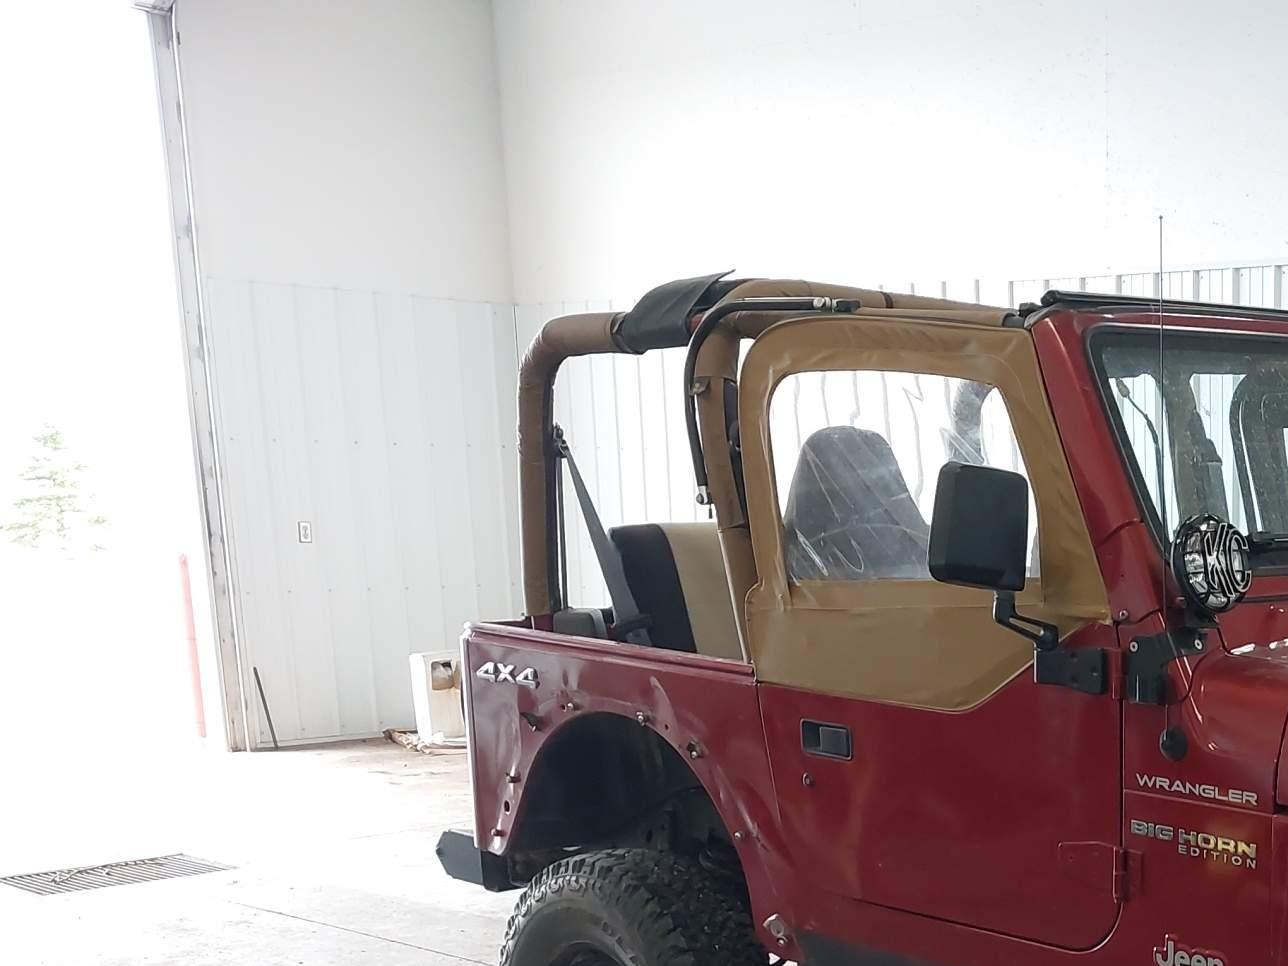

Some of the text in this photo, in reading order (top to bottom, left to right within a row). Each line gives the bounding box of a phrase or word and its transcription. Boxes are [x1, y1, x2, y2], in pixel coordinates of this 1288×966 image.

[1204, 522, 1252, 599] KC
[1135, 772, 1258, 806] WRANGLER
[1130, 819, 1257, 859] BIG HORN
[1177, 844, 1257, 870] EDITION
